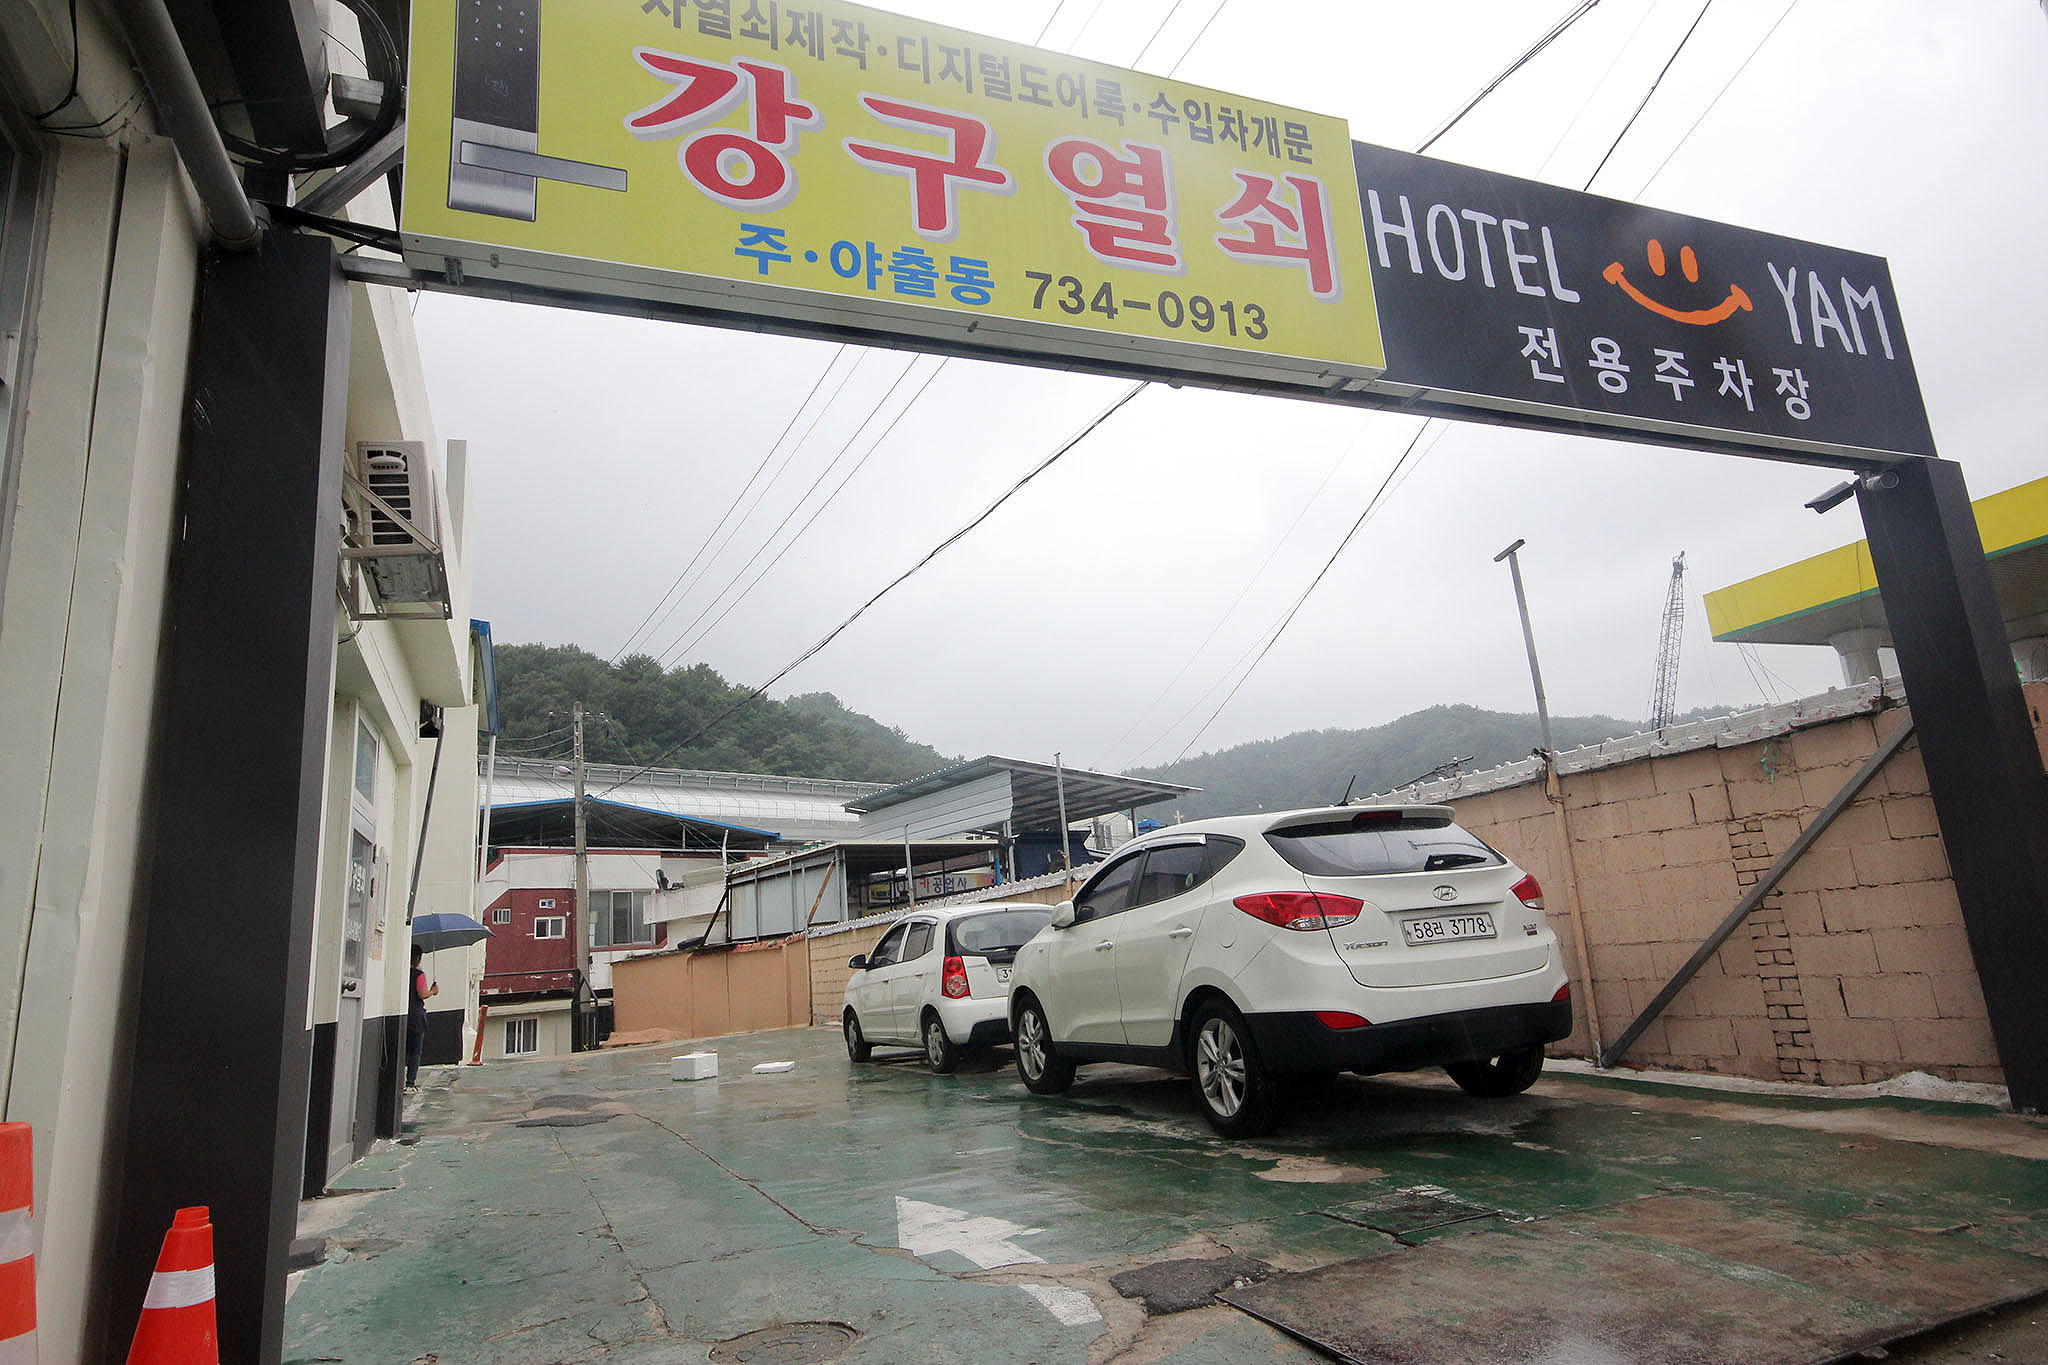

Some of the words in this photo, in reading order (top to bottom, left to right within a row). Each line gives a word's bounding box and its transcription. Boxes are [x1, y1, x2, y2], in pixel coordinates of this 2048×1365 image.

[626, 48, 1340, 300] 강구열쇠
[1025, 270, 1269, 341] 734-0913
[1367, 189, 1581, 303] HOTEL
[1767, 262, 1895, 360] YAM
[1517, 325, 1812, 420] 전용주차장
[1449, 917, 1487, 935] 3778
